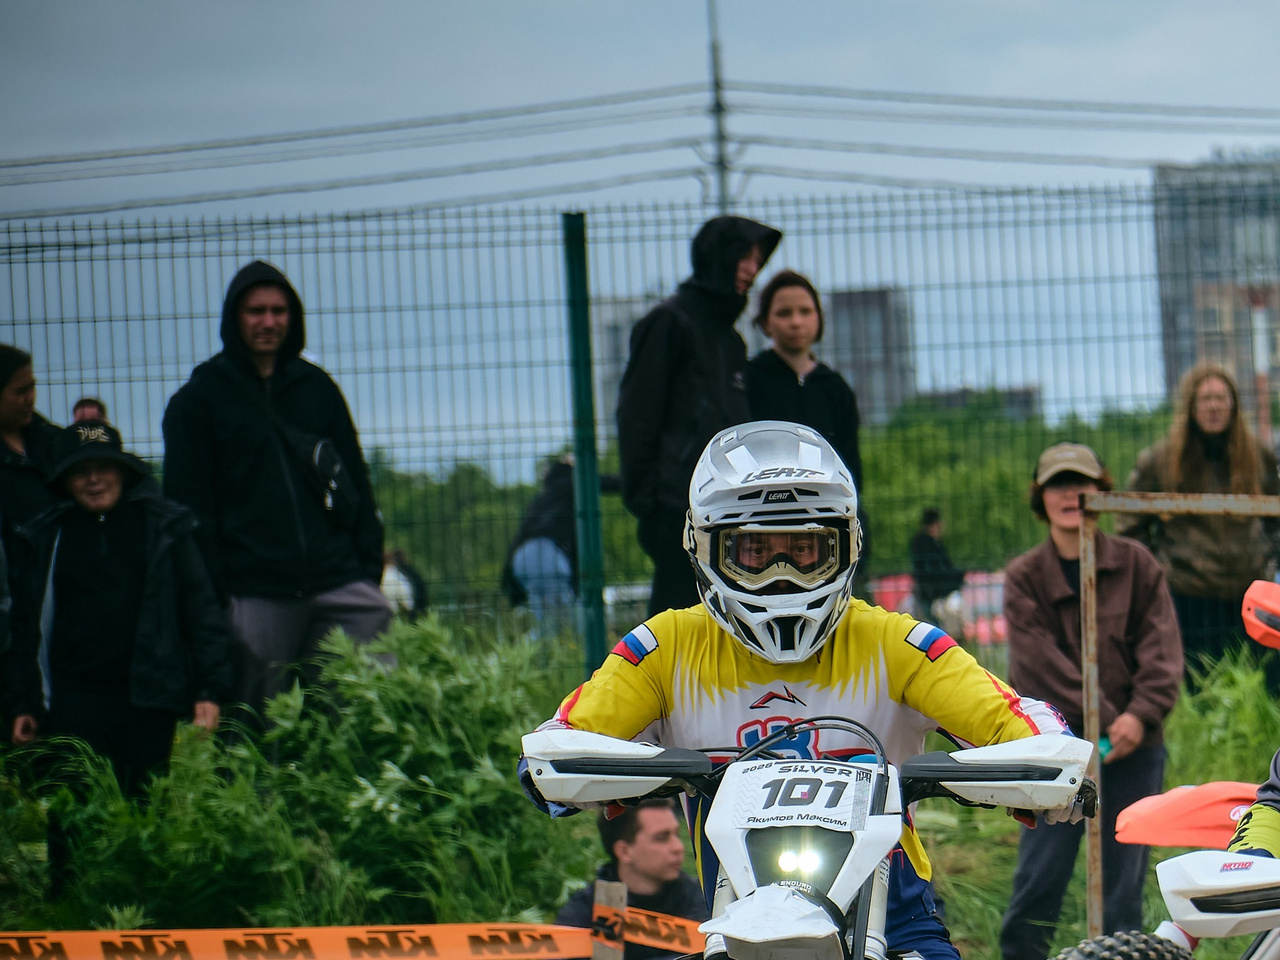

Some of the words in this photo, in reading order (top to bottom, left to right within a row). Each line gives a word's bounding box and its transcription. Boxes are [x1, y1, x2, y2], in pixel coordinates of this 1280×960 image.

[740, 467, 825, 484] LEATT
[768, 492, 790, 500] LEATT
[761, 777, 849, 809] 101
[746, 814, 794, 824] Якимов
[797, 813, 847, 826] Максим
